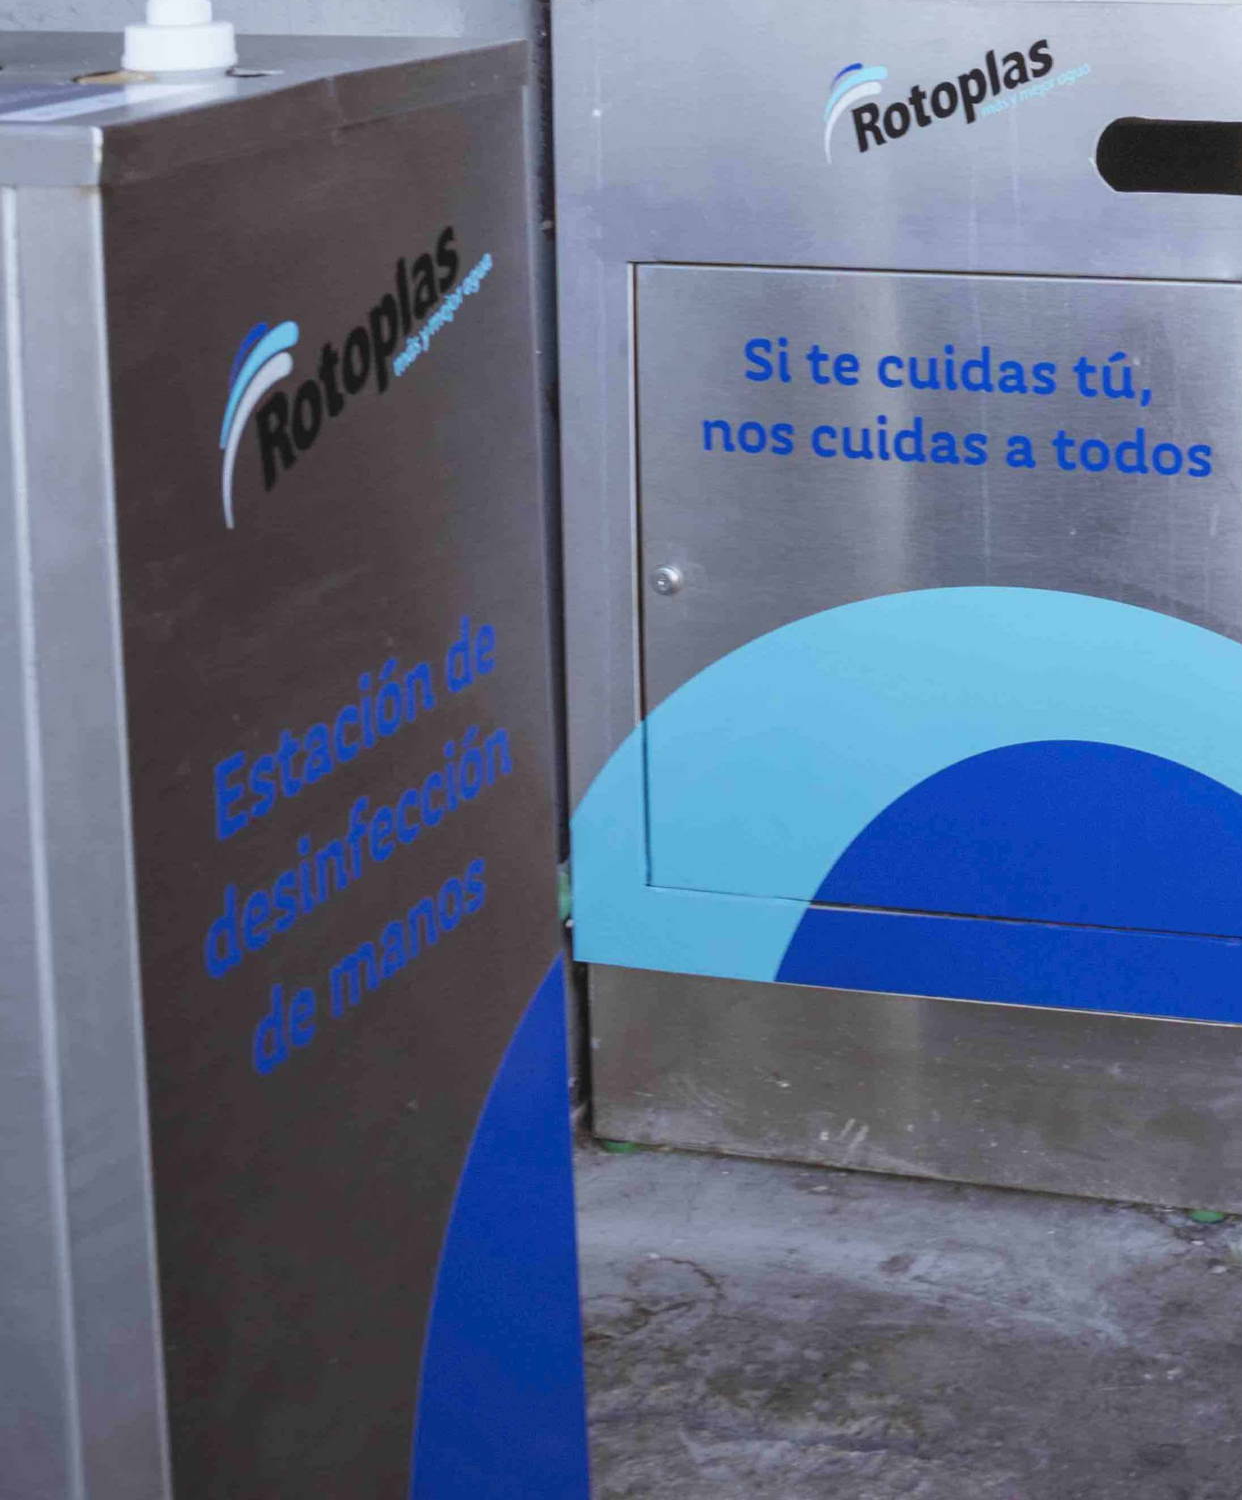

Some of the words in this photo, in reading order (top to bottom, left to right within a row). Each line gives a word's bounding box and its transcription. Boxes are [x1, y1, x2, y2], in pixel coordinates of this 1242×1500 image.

[851, 39, 1055, 154] Rotoplas
[255, 225, 460, 492] Rotoplas
[702, 418, 795, 456] nos
[811, 415, 989, 467] cuidas
[1006, 435, 1036, 469] a
[1052, 427, 1213, 478] todos
[744, 337, 793, 384] Si
[806, 344, 861, 386] te
[877, 345, 1057, 396] cuidas
[1073, 351, 1153, 407] tú,
[213, 656, 437, 842] Estación
[444, 614, 497, 694] de
[204, 724, 514, 980] desinfección
[251, 982, 317, 1076] de
[329, 856, 487, 1019] manos
